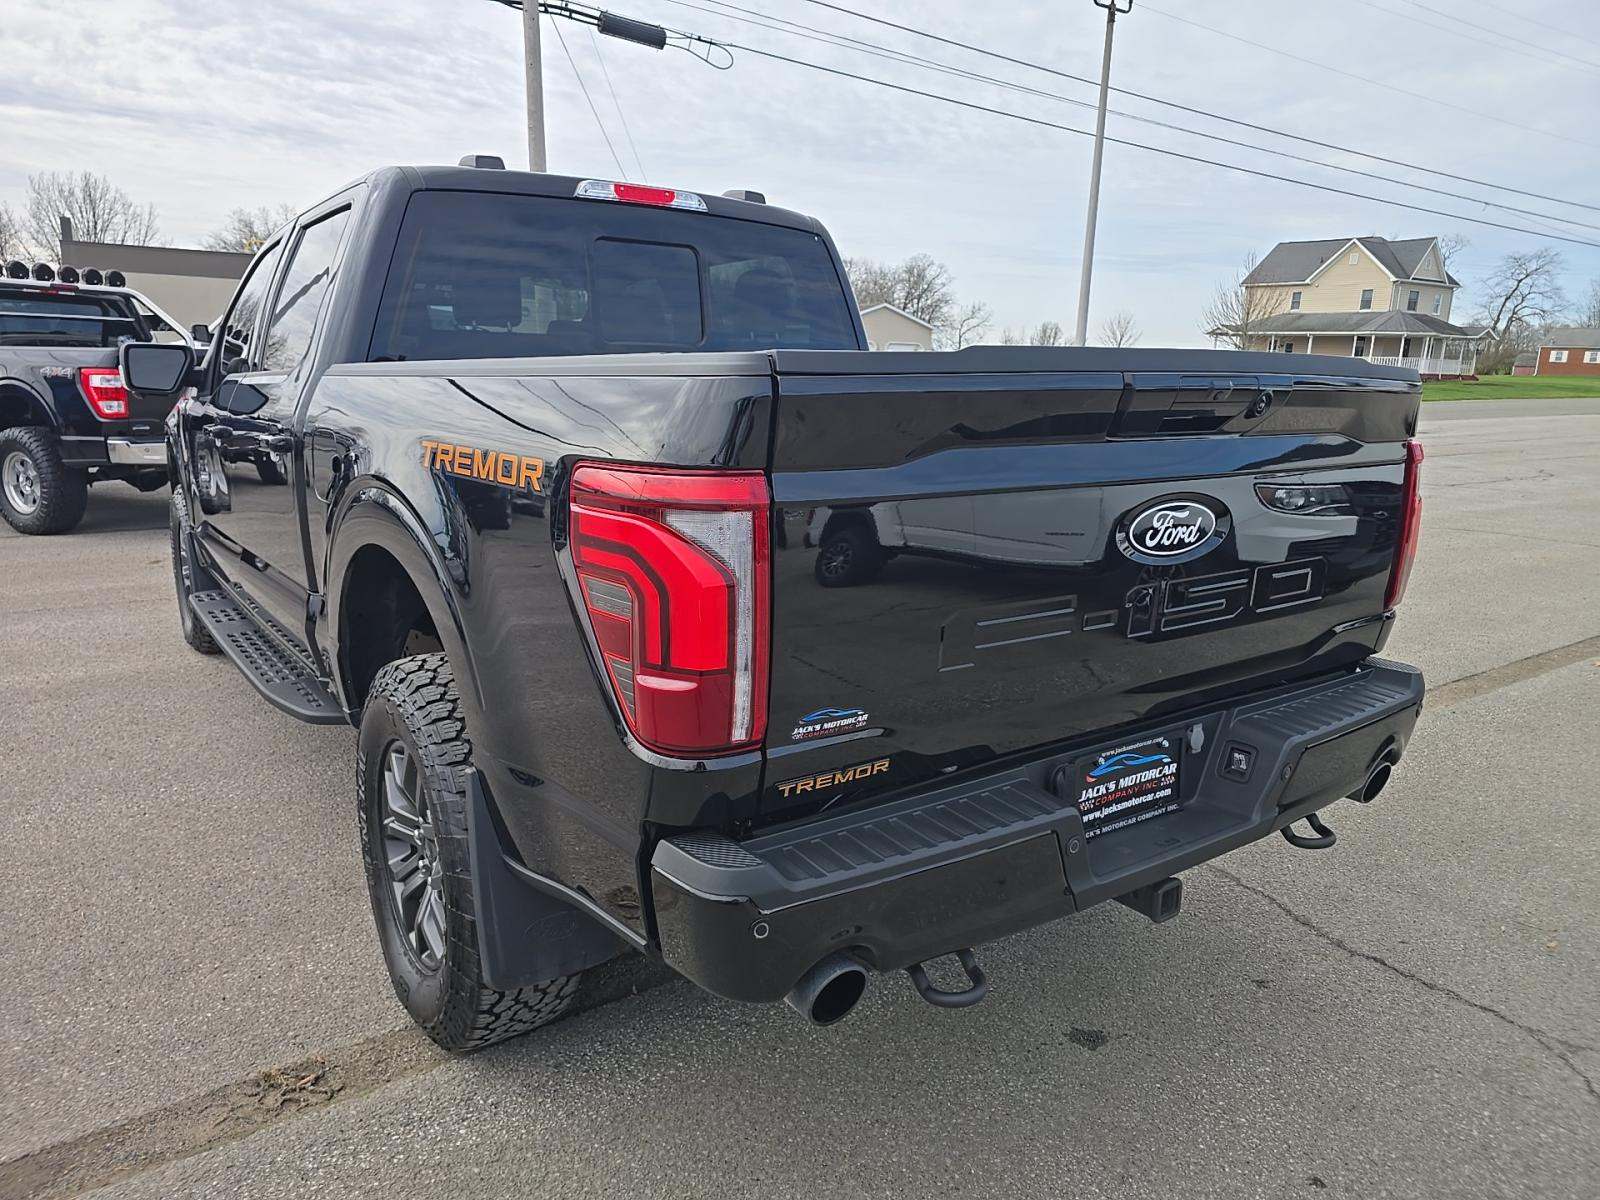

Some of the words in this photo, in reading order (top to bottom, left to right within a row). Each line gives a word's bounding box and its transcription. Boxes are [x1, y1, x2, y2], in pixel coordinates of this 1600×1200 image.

[420, 439, 545, 492] TREMOR
[1145, 510, 1203, 547] Ford
[937, 556, 1330, 673] F-150
[792, 723, 821, 735] JACK'S
[822, 714, 869, 729] MOTORCAR
[804, 727, 838, 738] COMPANY
[778, 758, 890, 798] TREMOR
[1078, 781, 1117, 802] JACK'S
[1118, 763, 1178, 789] MOTORCAR
[1095, 786, 1140, 806] COMPANY
[1082, 788, 1172, 823] www.jacksmotorcar.com
[1085, 828, 1101, 839] CK'S
[1101, 817, 1136, 834] MOTORCAR
[1137, 807, 1167, 823] COMPANY
[1167, 803, 1180, 812] INC.
